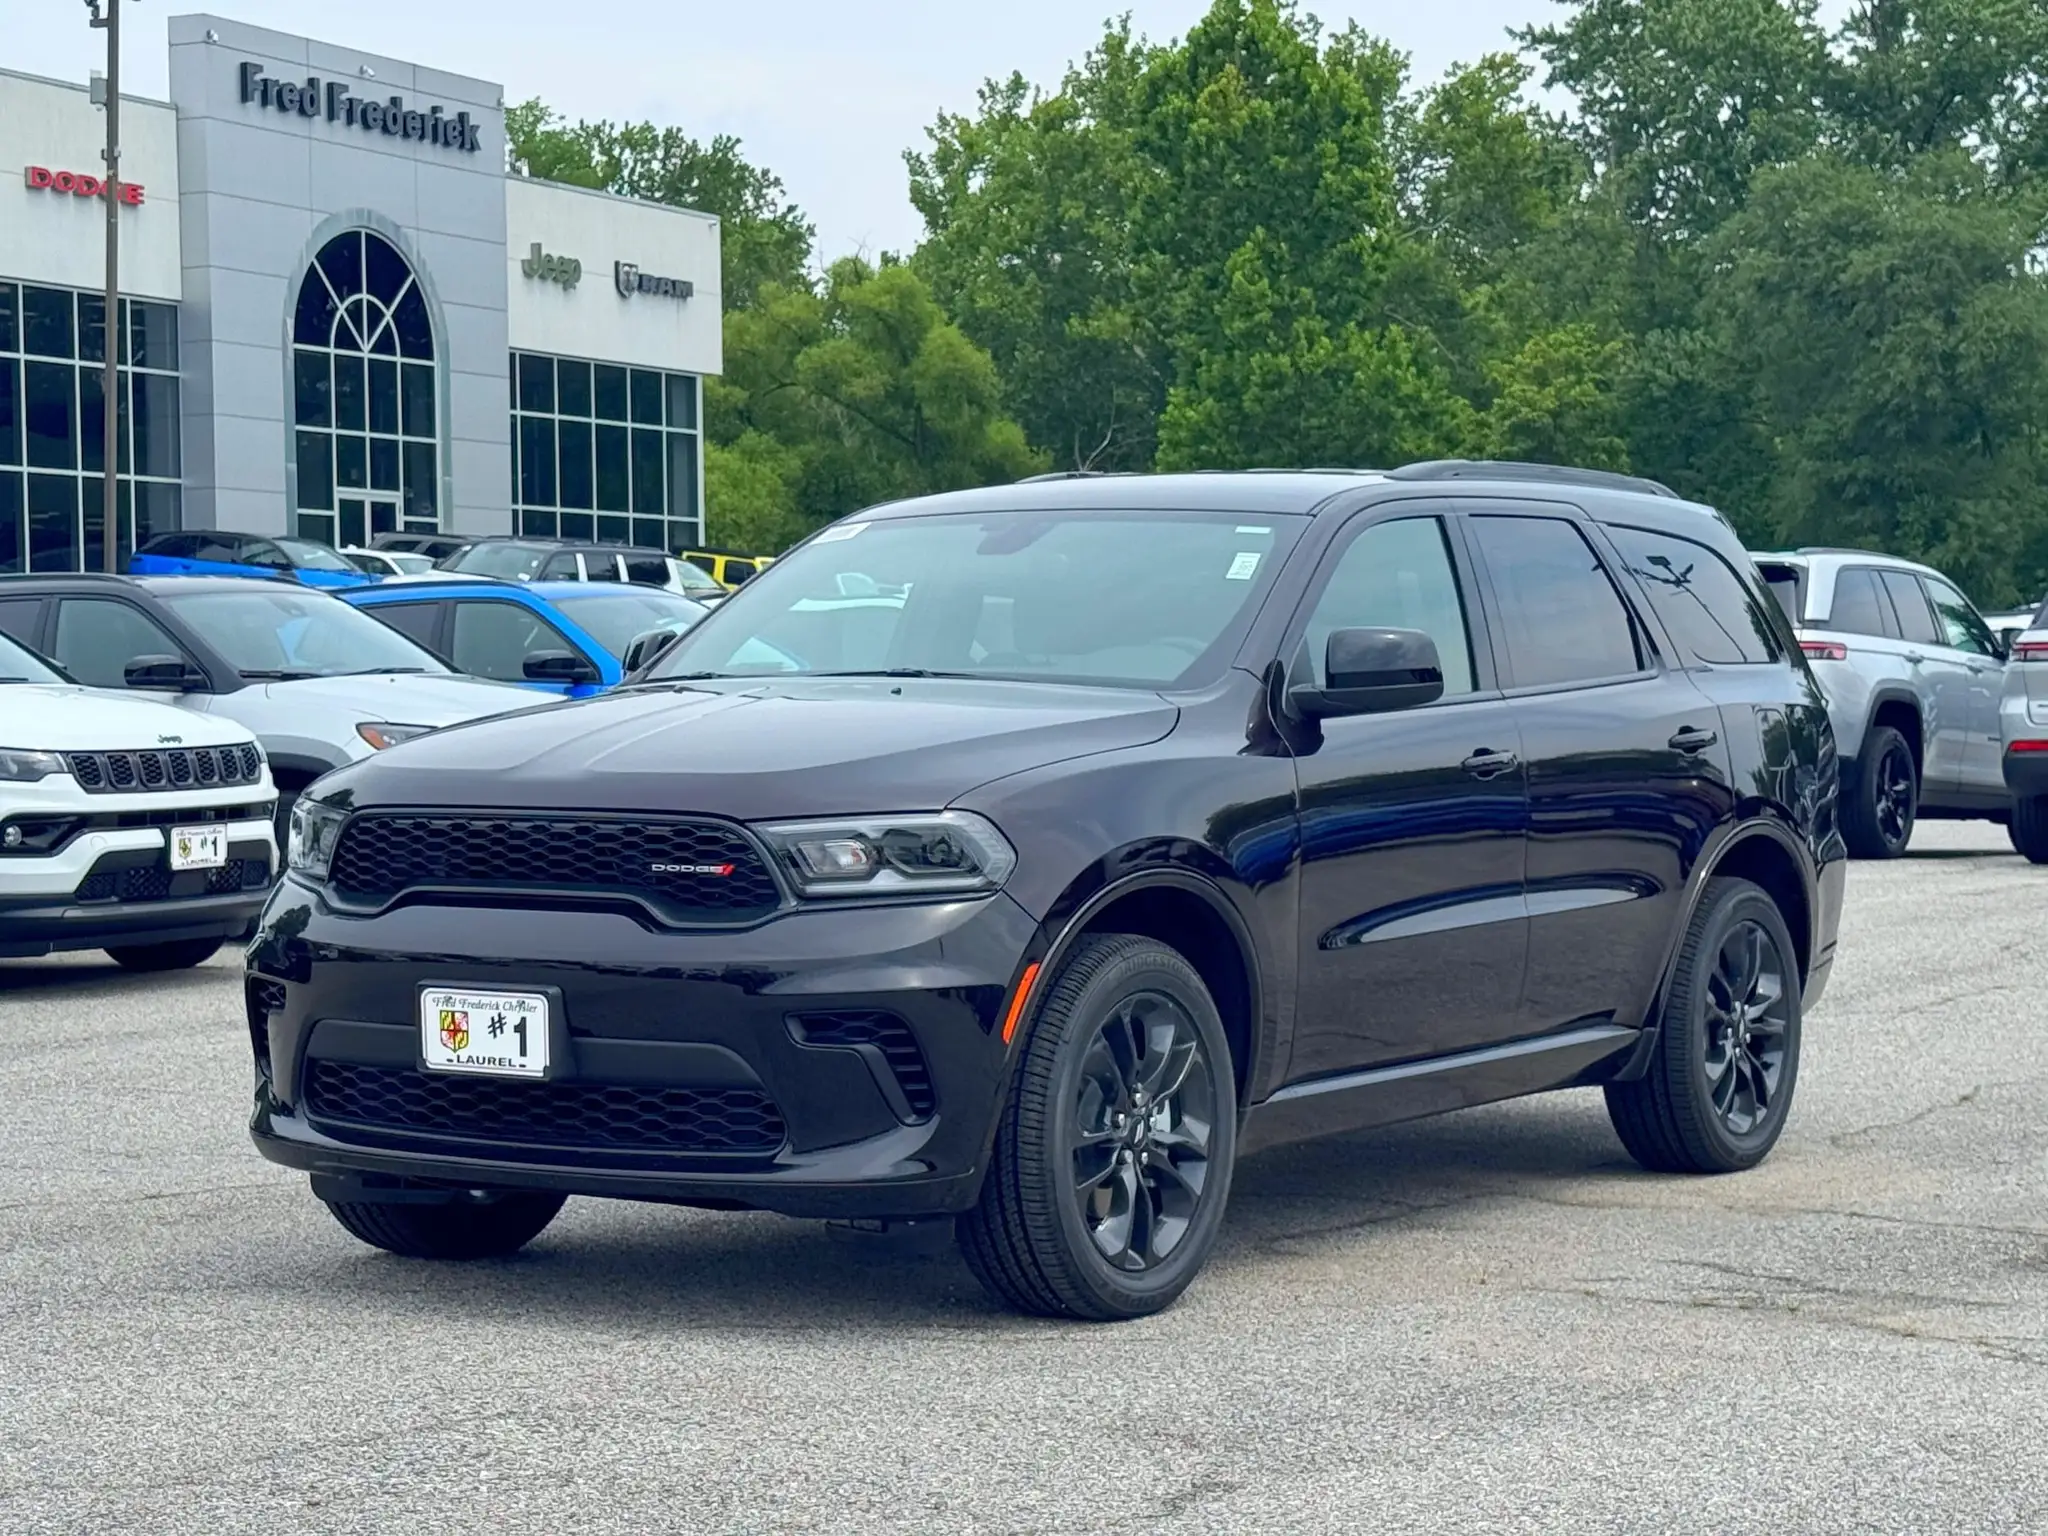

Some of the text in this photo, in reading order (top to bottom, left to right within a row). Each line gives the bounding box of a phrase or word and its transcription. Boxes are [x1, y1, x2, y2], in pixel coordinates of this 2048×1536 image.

[240, 62, 482, 151] Fred Frederick
[521, 242, 582, 291] Jeep
[638, 273, 694, 300] RAM
[651, 863, 724, 873] DODGE
[432, 996, 538, 1014] Fred Frederick Chrysler
[456, 1054, 517, 1068] LAUREL
